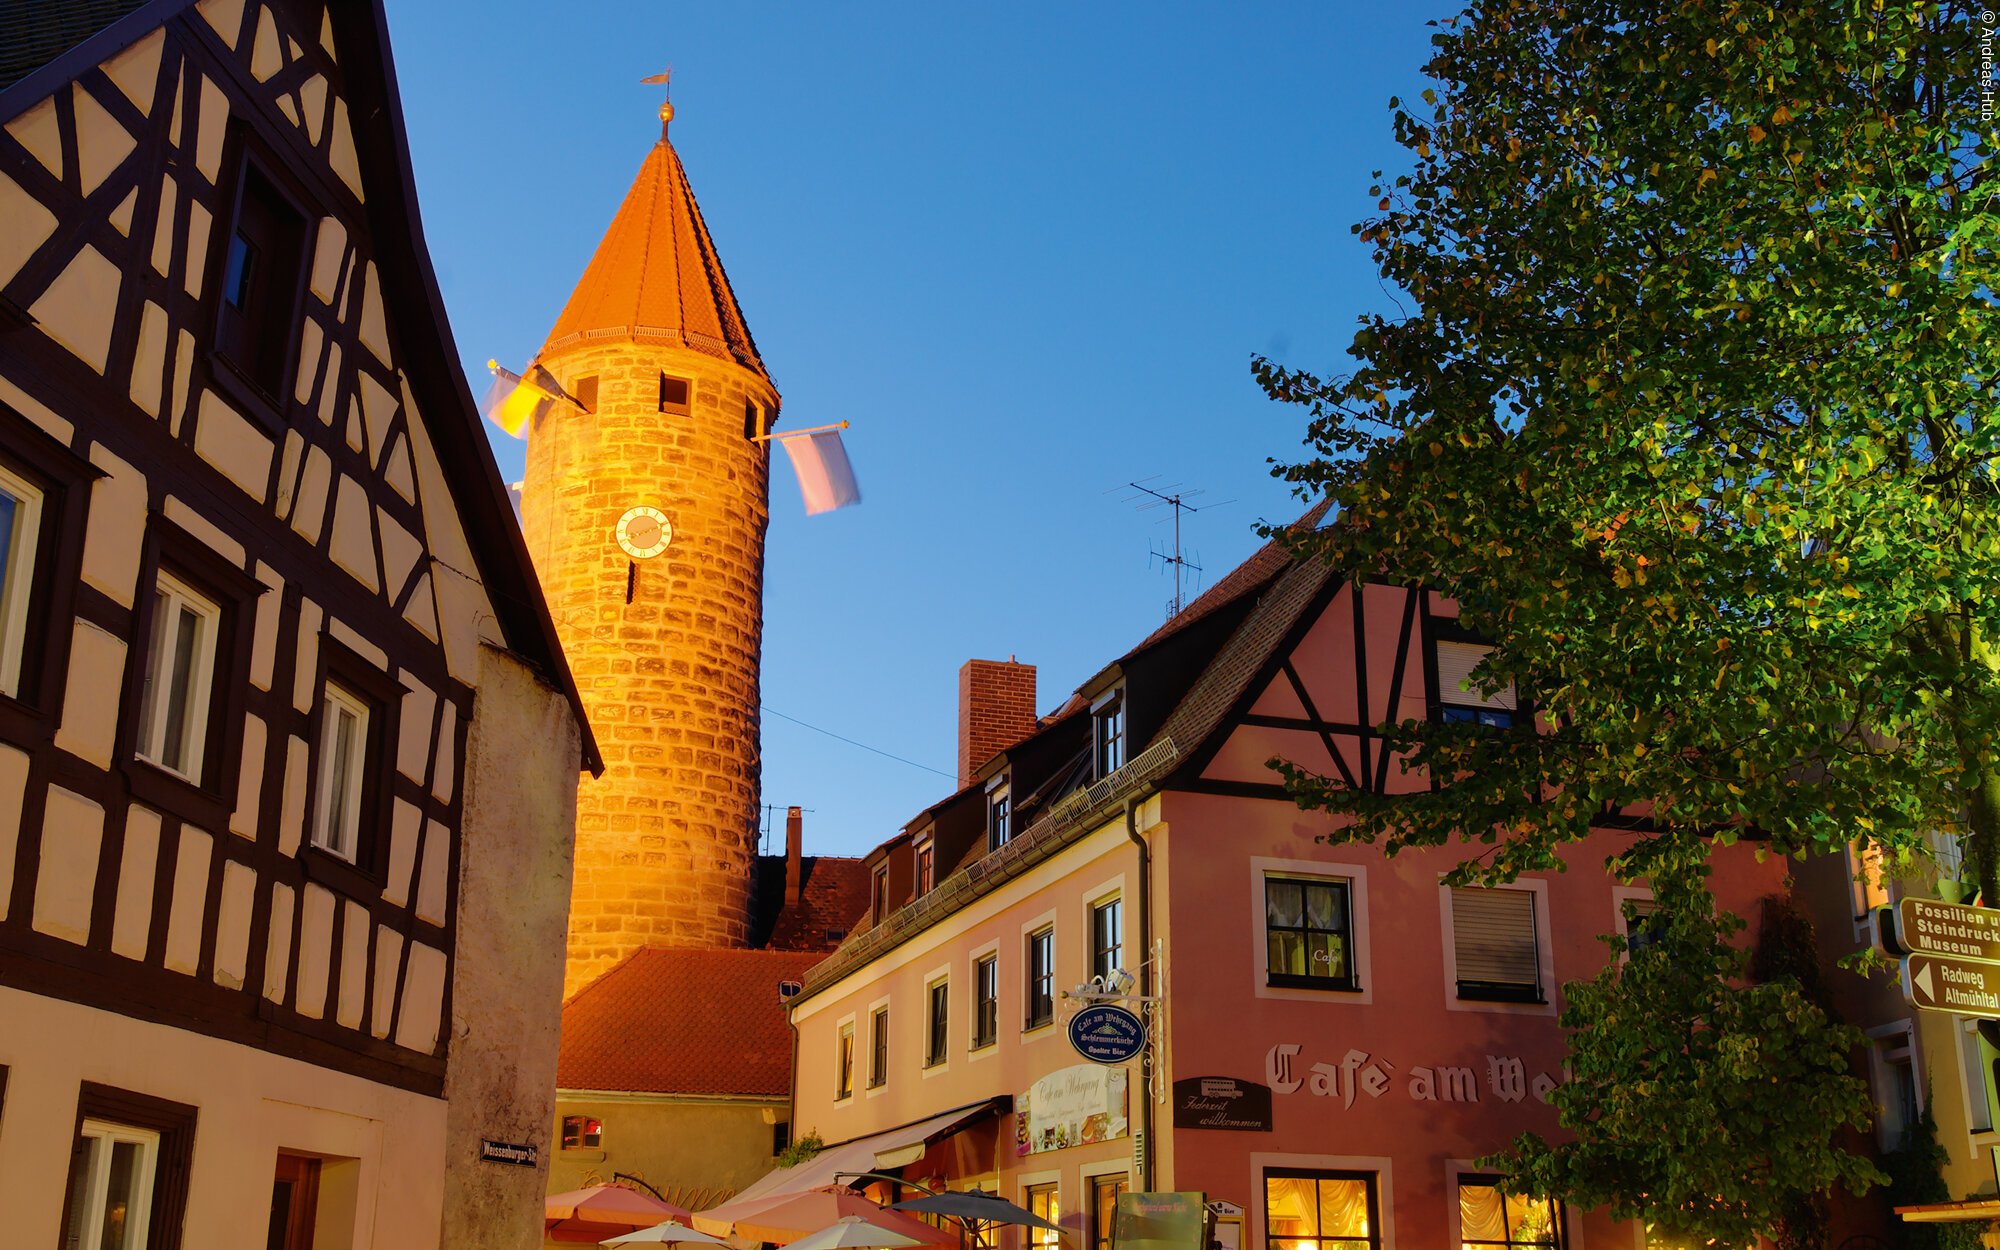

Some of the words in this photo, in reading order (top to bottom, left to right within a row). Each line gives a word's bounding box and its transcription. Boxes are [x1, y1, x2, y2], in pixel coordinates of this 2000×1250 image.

[1915, 902, 1984, 925] Fossilien
[1917, 919, 2000, 943] Steindruck
[1919, 935, 1982, 956] Museum
[1941, 965, 1985, 990] Radweg
[1945, 987, 1999, 1009] Altmühltal
[1093, 1014, 1103, 1023] am
[1105, 1012, 1137, 1036] Wehrgang
[1112, 1047, 1126, 1056] Bier
[1409, 1065, 1480, 1103] am
[1200, 1112, 1261, 1128] willkommen
